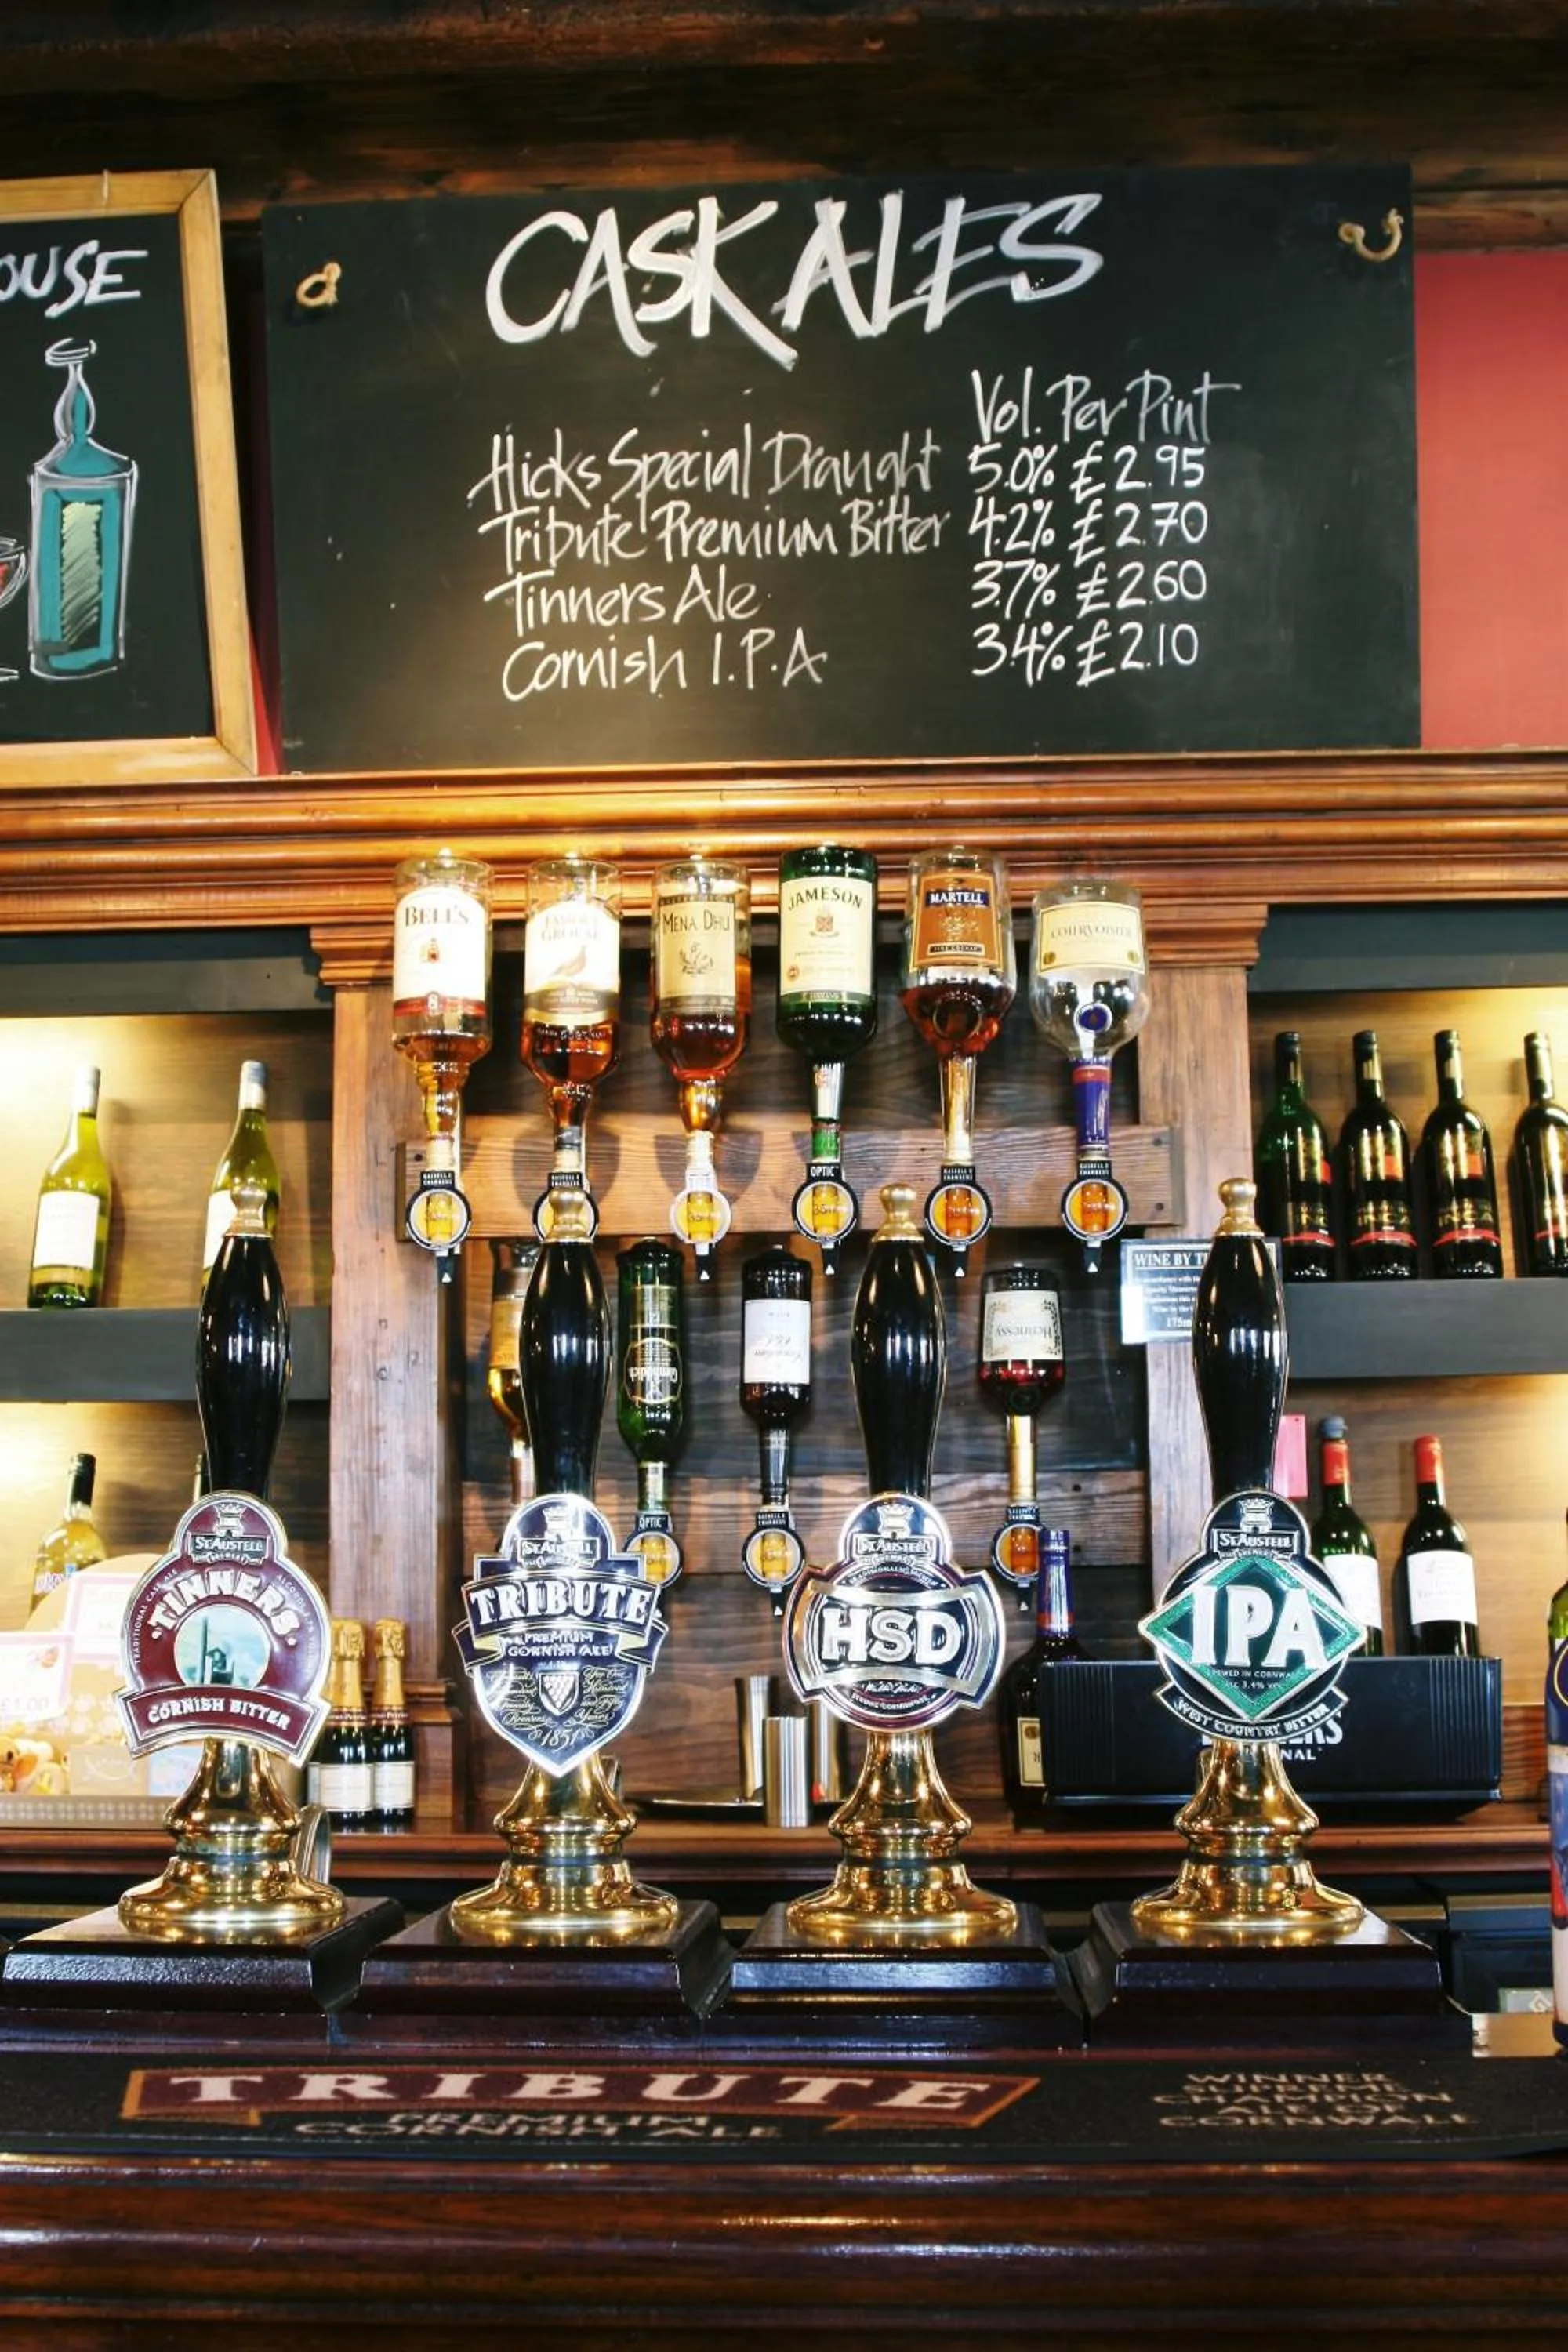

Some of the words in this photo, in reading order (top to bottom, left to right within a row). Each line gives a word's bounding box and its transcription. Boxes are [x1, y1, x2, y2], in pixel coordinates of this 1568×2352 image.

[486, 196, 799, 372] CASK
[771, 189, 1103, 339] ALES
[971, 366, 1042, 444] Vol.
[1046, 374, 1127, 443] Per
[1125, 369, 1242, 445] Pint
[466, 426, 601, 513] Hicks
[608, 423, 753, 534] Special
[763, 428, 941, 499] Draught
[478, 503, 647, 575] Tribute
[651, 500, 837, 563] Premium
[842, 495, 951, 558] Bitter
[484, 568, 666, 637] Tinners
[673, 564, 760, 625] Ale
[503, 634, 688, 701] Cornish
[788, 887, 863, 911] JAMESON
[930, 891, 984, 904] MARTELL
[662, 911, 698, 935] MENA
[1136, 1253, 1171, 1267] WINE
[1176, 1253, 1192, 1266] BY
[1167, 1317, 1192, 1328] 175m
[147, 1569, 301, 1636] TINNERS
[470, 1579, 653, 1626] TRIBUTE
[524, 1631, 595, 1644] PREMIUM
[822, 1608, 962, 1666] HSD
[1190, 1584, 1330, 1671] IPA
[508, 1644, 576, 1657] CORNISH
[579, 1644, 613, 1657] ALE
[147, 1697, 225, 1724] CORNISH
[230, 1699, 291, 1731] BITTER
[1175, 1697, 1213, 1726] WEST
[1214, 1719, 1280, 1738] COUNTRY
[1283, 1703, 1330, 1732] BITTER
[170, 2073, 990, 2111] TRIBUTE
[1186, 2072, 1388, 2084] WINNER
[1152, 2092, 1454, 2105] CHAMPION
[293, 2122, 619, 2136] CORNISH
[645, 2125, 782, 2139] ALE
[1159, 2114, 1481, 2127] CORNWALL
